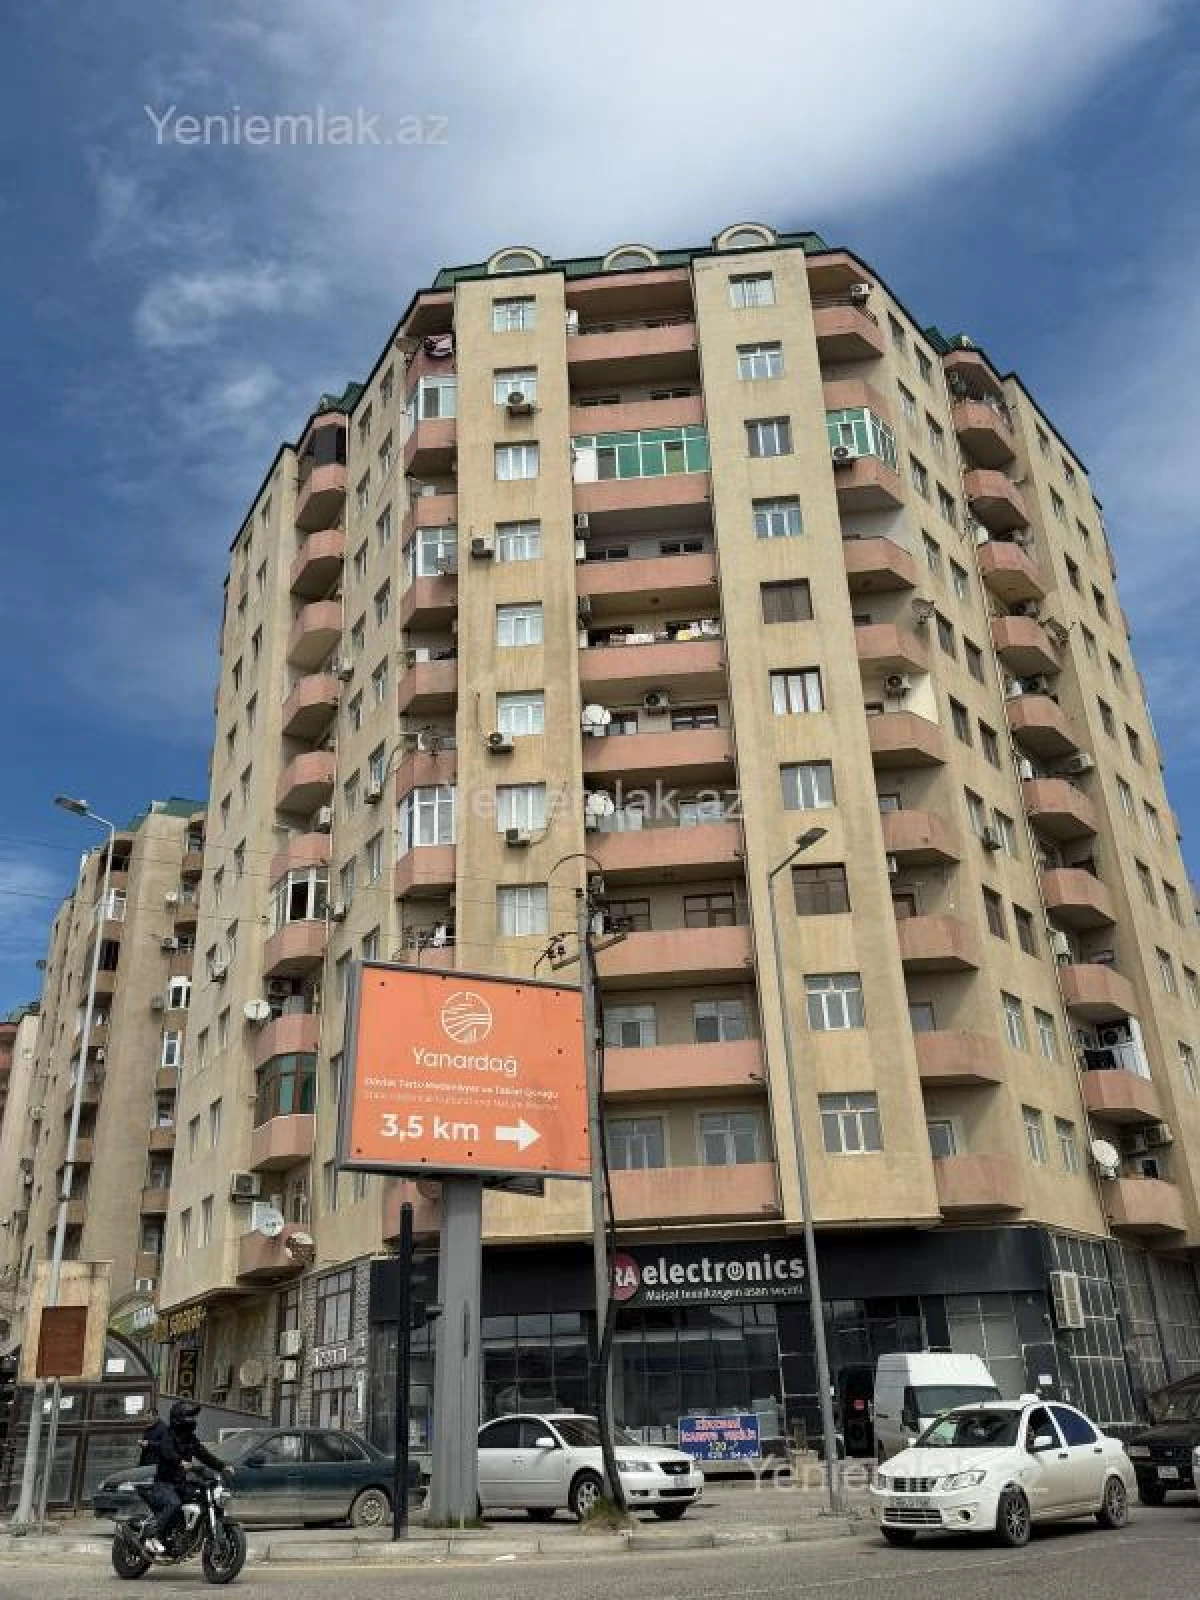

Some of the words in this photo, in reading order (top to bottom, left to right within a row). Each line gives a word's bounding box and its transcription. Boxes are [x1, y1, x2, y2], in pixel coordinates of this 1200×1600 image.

[381, 1113, 424, 1142] 3,5
[433, 1116, 479, 1141] km
[642, 1253, 805, 1285] electronics
